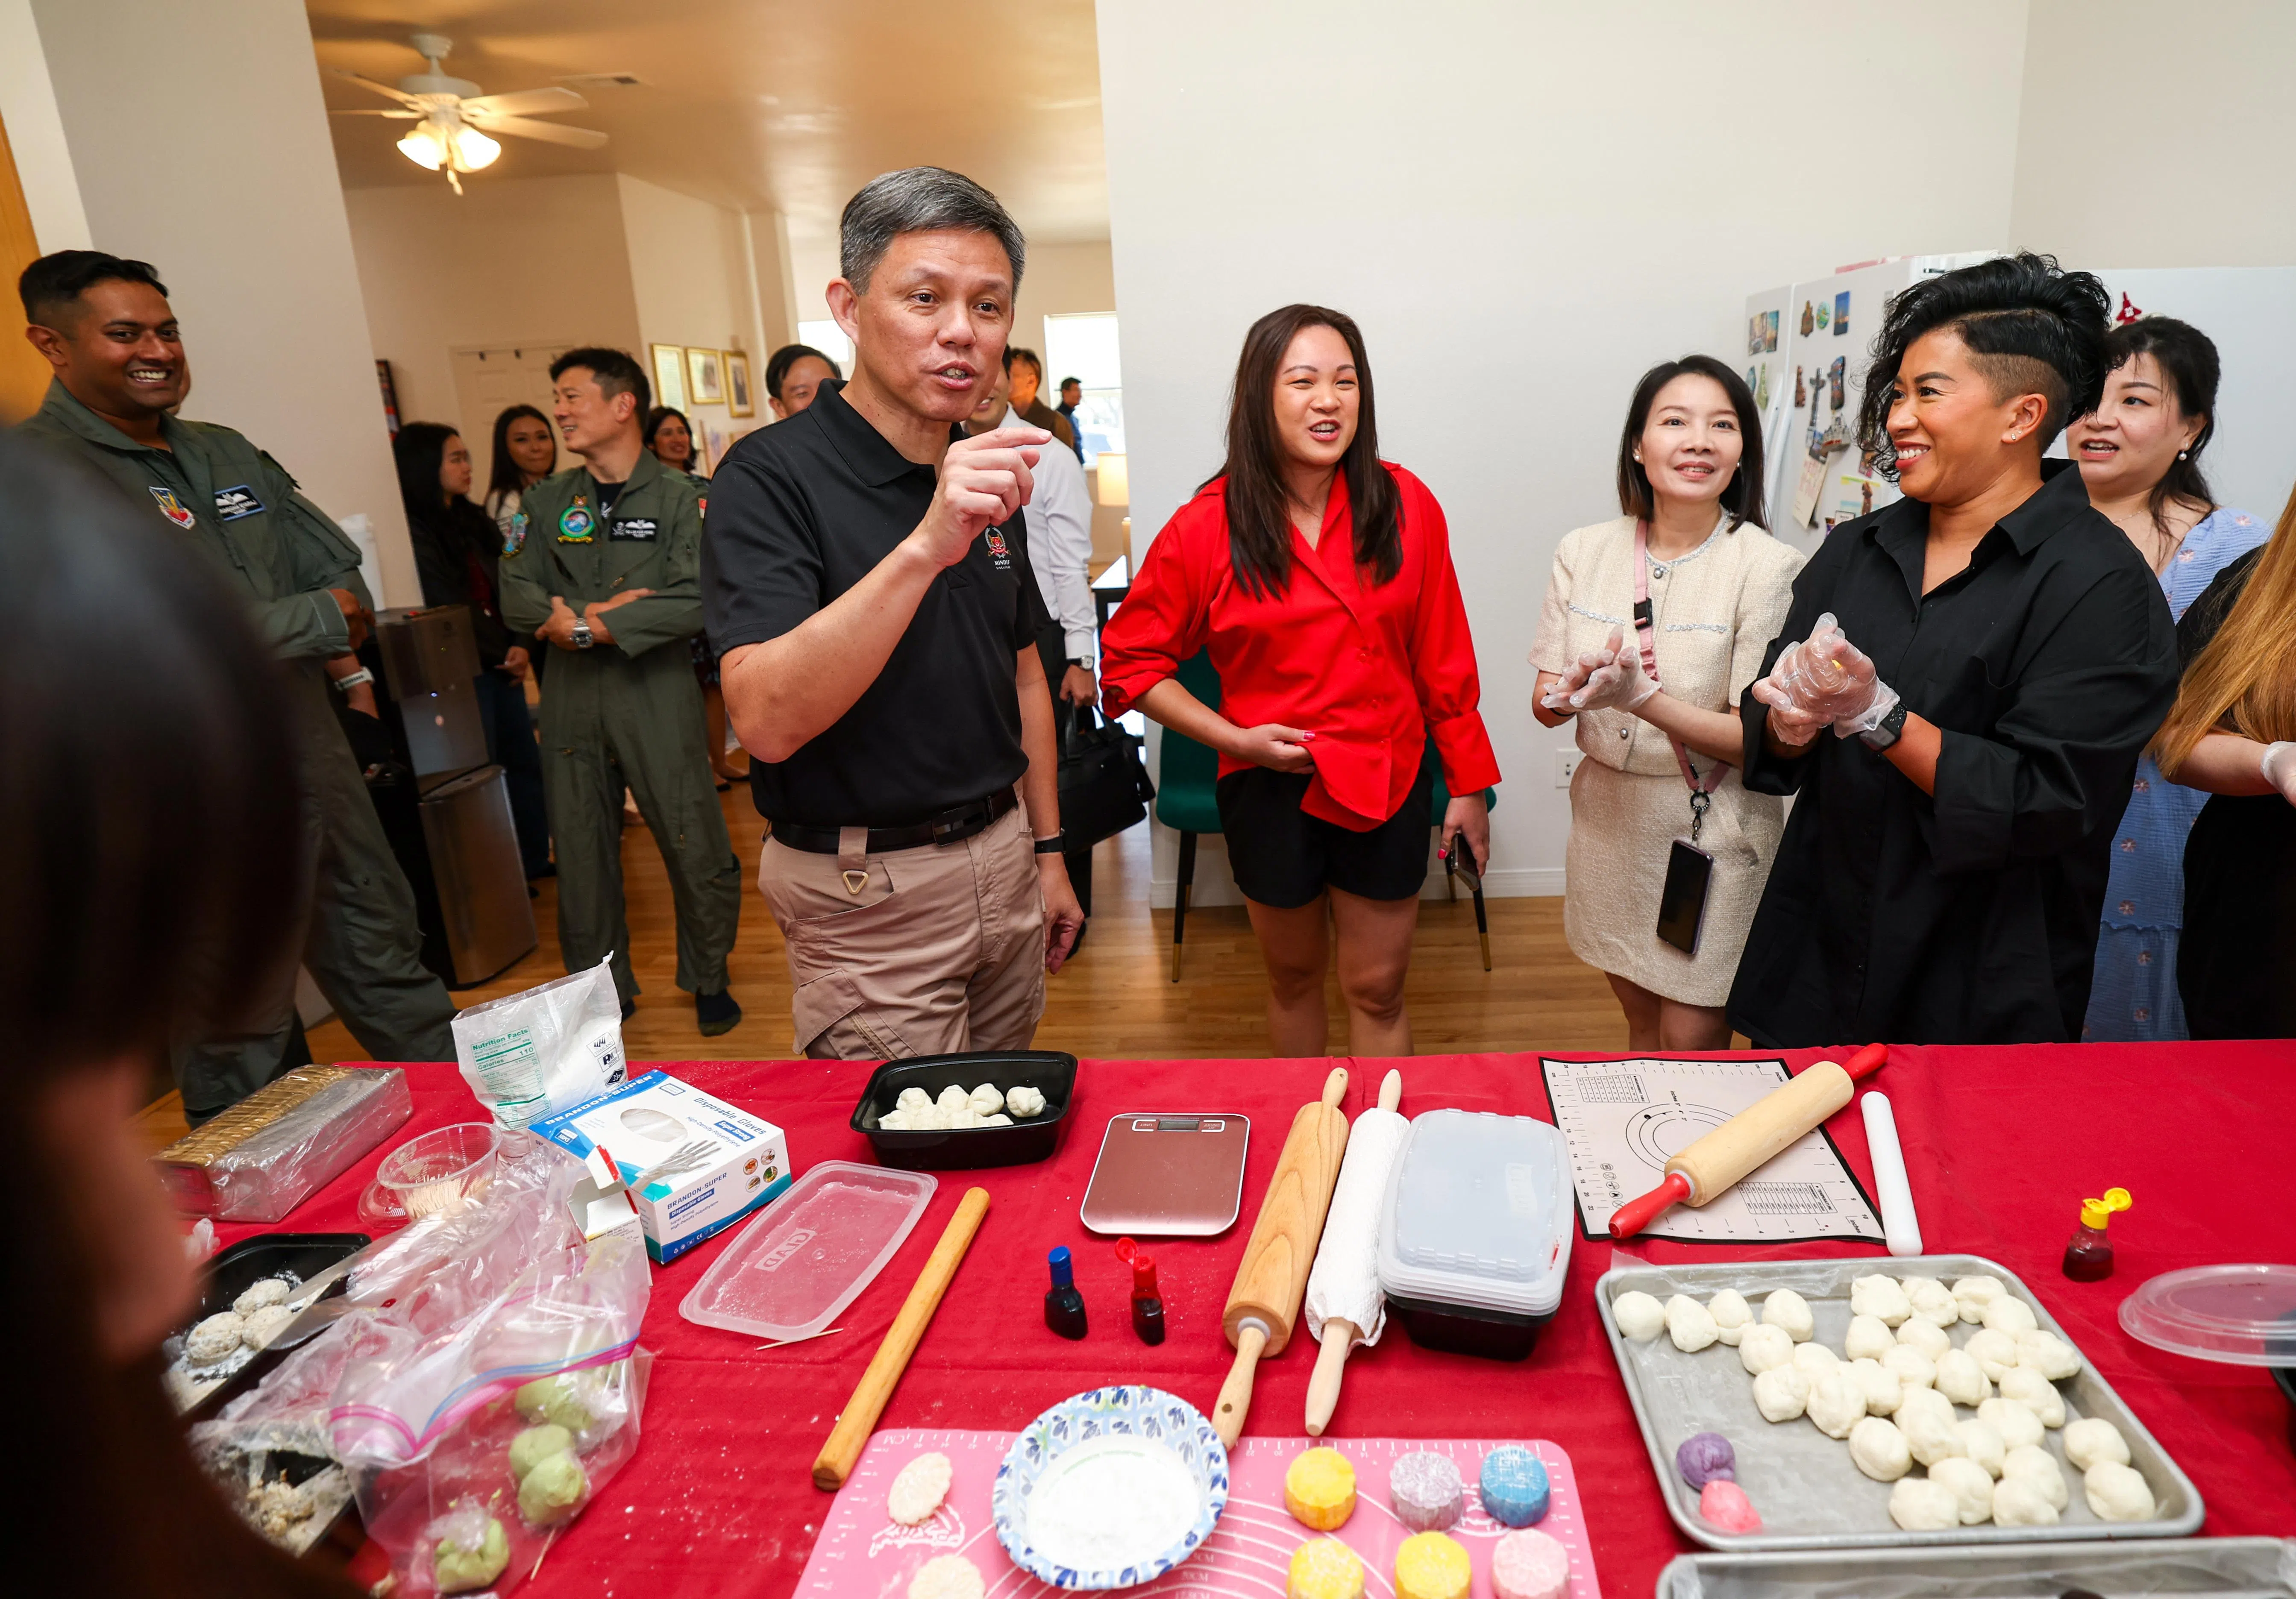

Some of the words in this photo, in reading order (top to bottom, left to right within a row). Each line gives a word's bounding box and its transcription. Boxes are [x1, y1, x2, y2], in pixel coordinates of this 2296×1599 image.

[473, 1037, 505, 1050] Nutrition
[507, 1029, 528, 1039] Facts
[594, 1041, 614, 1055] THAILAND
[478, 1059, 505, 1070] Calories
[519, 1047, 534, 1056] 110
[1775, 1071, 1783, 1082] inches
[544, 1075, 653, 1125] BRANDON-SUPER
[693, 1097, 737, 1119] Disposable
[737, 1118, 766, 1135] Gloves
[687, 1116, 713, 1133] High-Density
[712, 1130, 741, 1147] Polyethylene
[718, 1121, 734, 1133] Super
[733, 1129, 752, 1140] Strong
[667, 1173, 727, 1209] BRANDON-SUPER
[1817, 1189, 1832, 1210] TEMPERATURE
[671, 1200, 697, 1217] Disposable
[697, 1190, 713, 1202] Gloves
[1850, 1220, 1861, 1234] inches
[883, 1435, 905, 1445] CM
